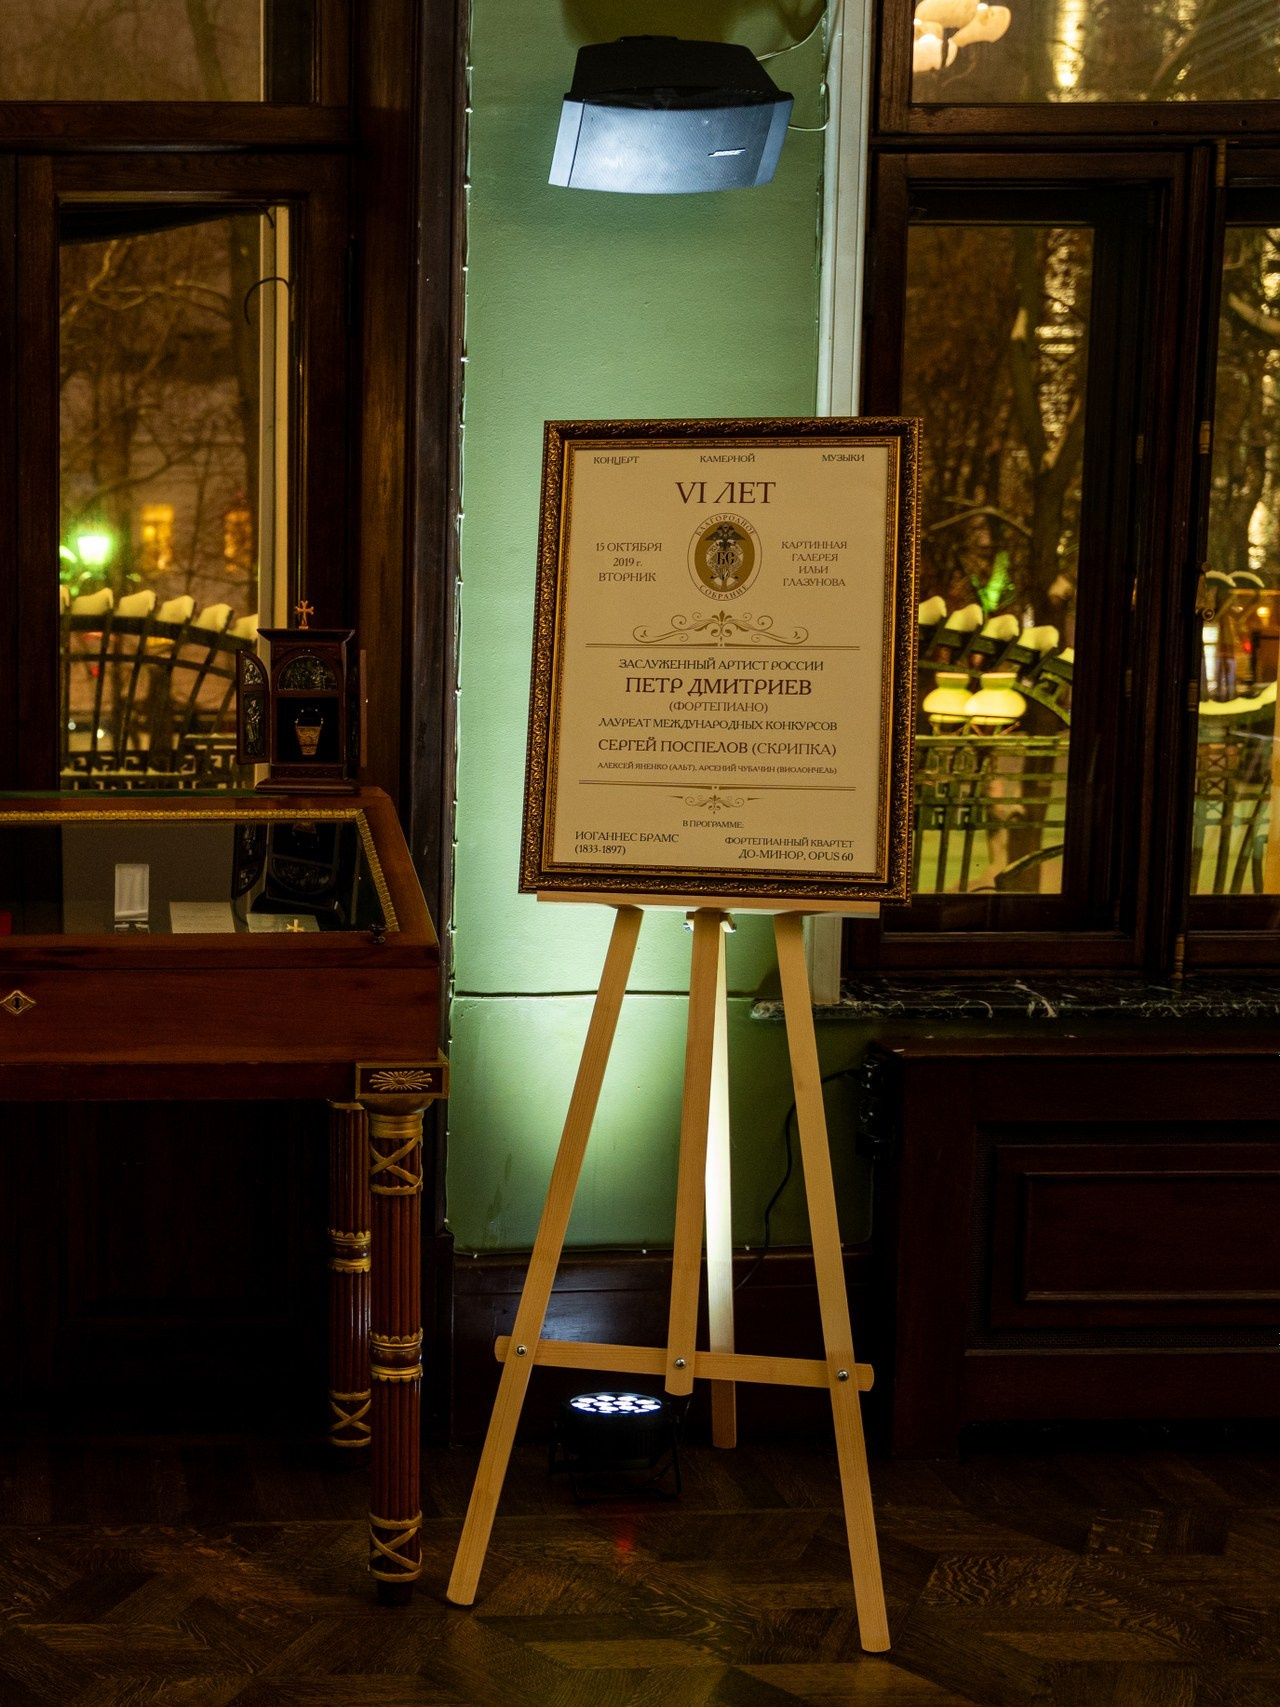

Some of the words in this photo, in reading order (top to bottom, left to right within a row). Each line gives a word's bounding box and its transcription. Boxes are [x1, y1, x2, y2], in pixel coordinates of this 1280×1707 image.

[594, 456, 639, 465] КОНЦЕРТ
[700, 453, 755, 463] КАМЕРНОЙ
[675, 482, 708, 504] VI
[713, 482, 776, 503] ЛЕТ
[596, 543, 604, 551] 15
[607, 543, 662, 551] ОКТЯБРЯ
[782, 541, 847, 549] КАРТИННАЯ
[613, 558, 634, 566] 2019
[717, 551, 735, 565] БС
[799, 566, 828, 574] ИЛЬИ
[599, 573, 656, 581] ВТОРНИК
[783, 578, 846, 586] ГЛАЗУНОВА
[699, 584, 748, 600] СОБРАНИЕ
[619, 657, 715, 669] ЗАСЛУЖЕННЫЙ
[718, 660, 769, 670] АРТИСТ
[771, 661, 823, 671] РОССИИ
[625, 677, 683, 693] ПЕТР
[687, 679, 812, 697] ДМИТРИЕВ
[669, 701, 768, 713] (ФОРТЕПИАНО)
[598, 718, 651, 727] ЛАУРЕАТ
[653, 719, 763, 730] МЕЖДУНАРОДНЫХ
[766, 721, 837, 731] КОНКУРСОВ
[598, 737, 656, 751] СЕРГЕЙ
[661, 741, 748, 753] ПОСПЕЛОВ
[752, 743, 836, 757] (СКРИПКА)
[690, 820, 744, 828] ПРОГРАММЕ:
[576, 831, 637, 841] ИОГАННЕС
[640, 833, 679, 843] БРАМС
[725, 837, 808, 846] ФОРТЕПИАННЫЙ
[811, 840, 854, 848] КВАРТЕТ
[575, 844, 626, 855] (1833-1897)
[739, 849, 806, 860] ДО-МИНОР,
[808, 851, 840, 861] OPUS
[842, 853, 853, 861] 60
